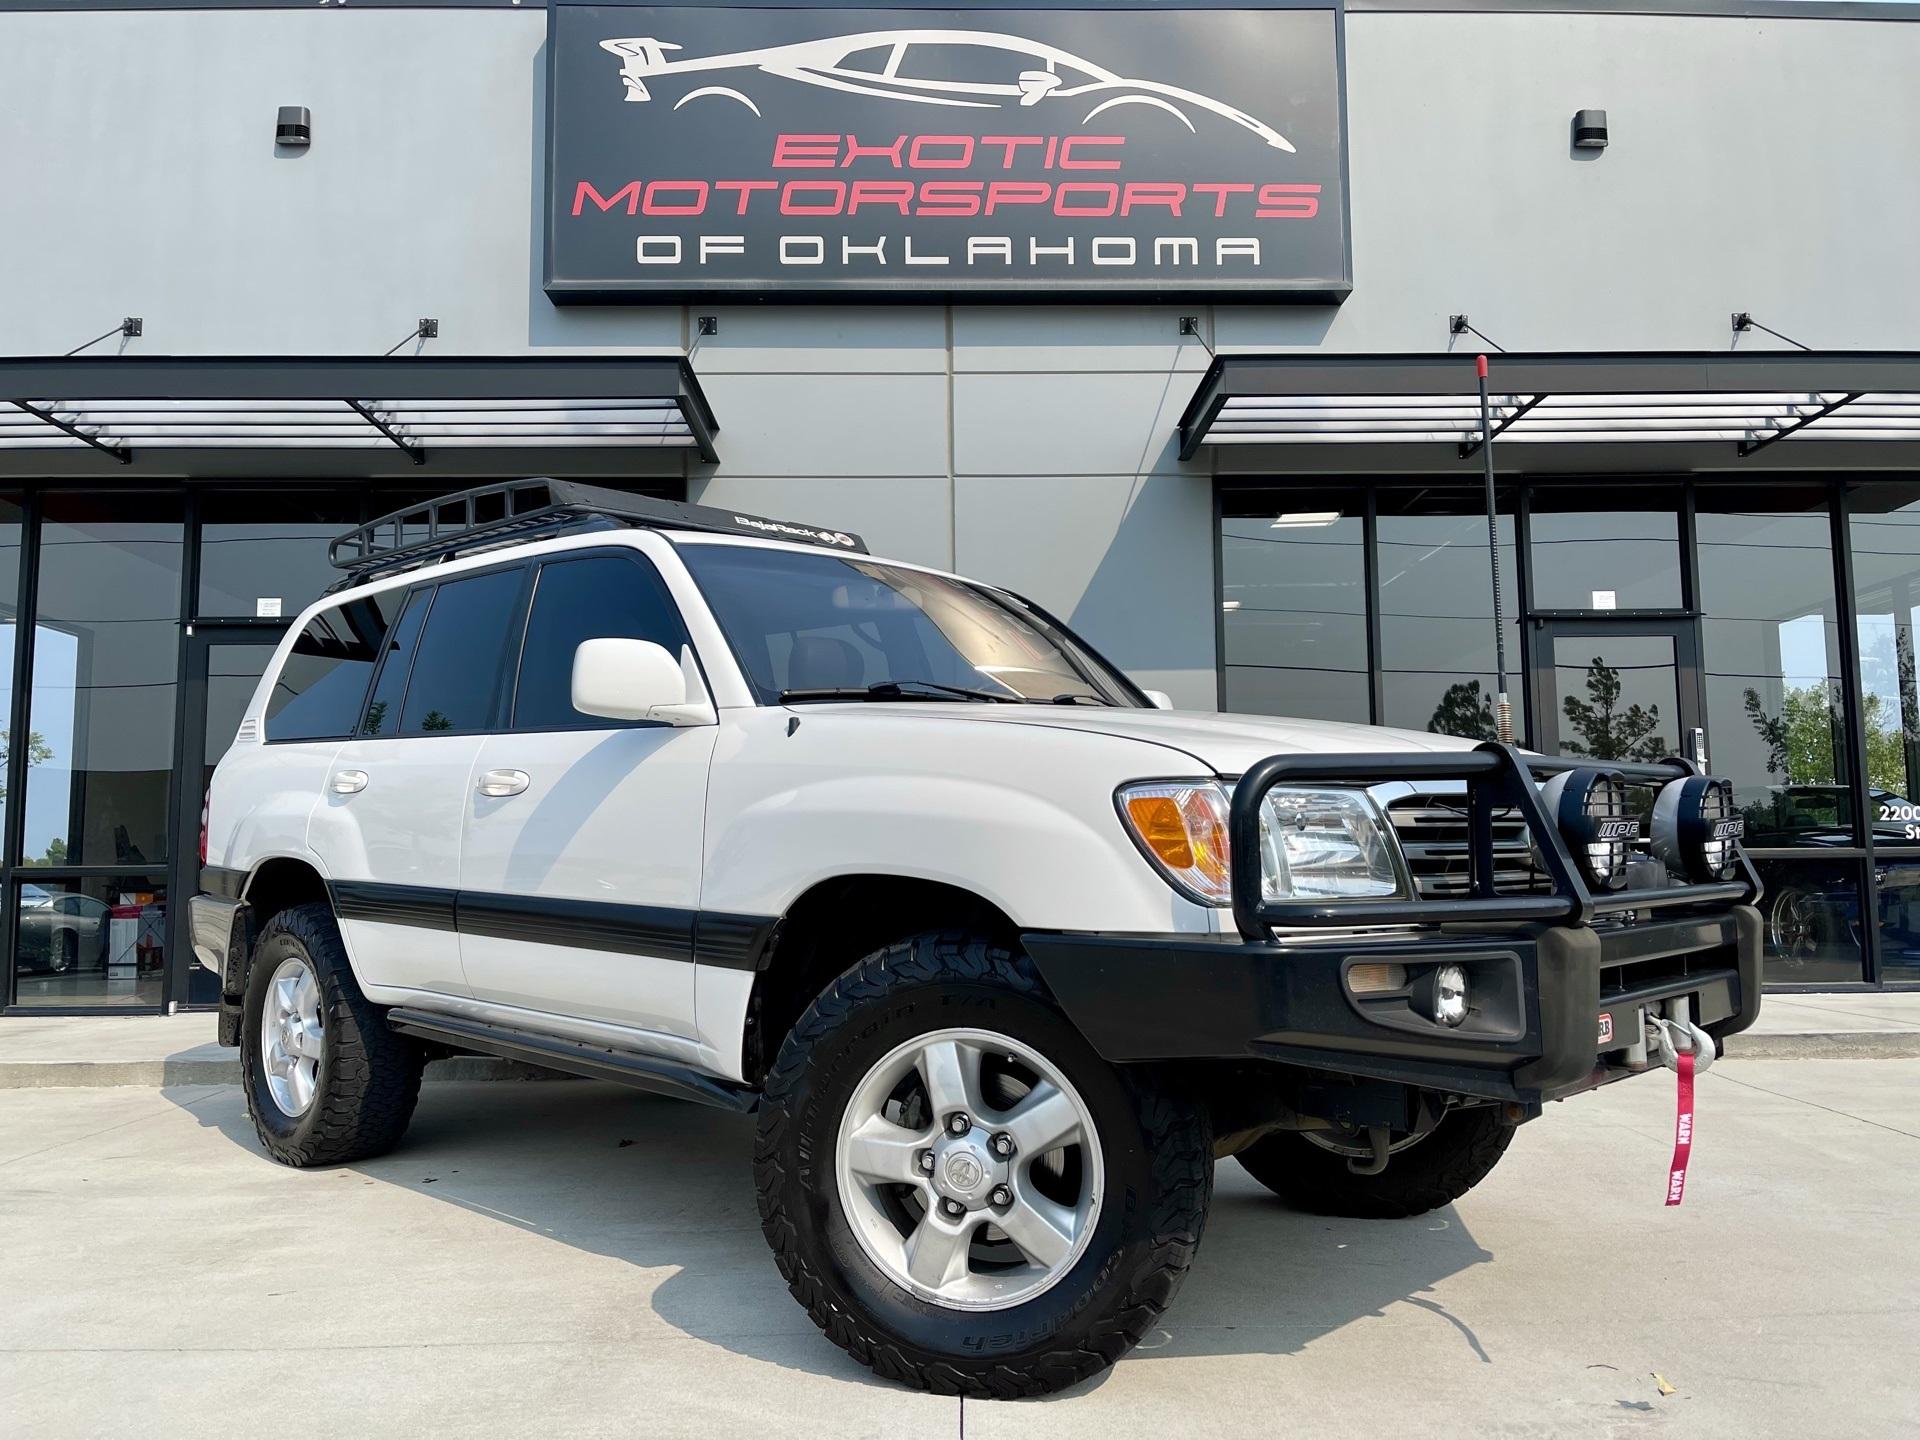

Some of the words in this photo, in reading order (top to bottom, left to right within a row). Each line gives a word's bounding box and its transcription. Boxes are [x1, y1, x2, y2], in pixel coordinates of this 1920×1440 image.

[772, 134, 1126, 170] EXOTIC
[571, 180, 1322, 218] MOTORSPORTS
[636, 235, 745, 265] OF
[779, 235, 1261, 266] OKLAHOMA
[1677, 1113, 1692, 1145] WARN
[1668, 1169, 1684, 1201] WARN
